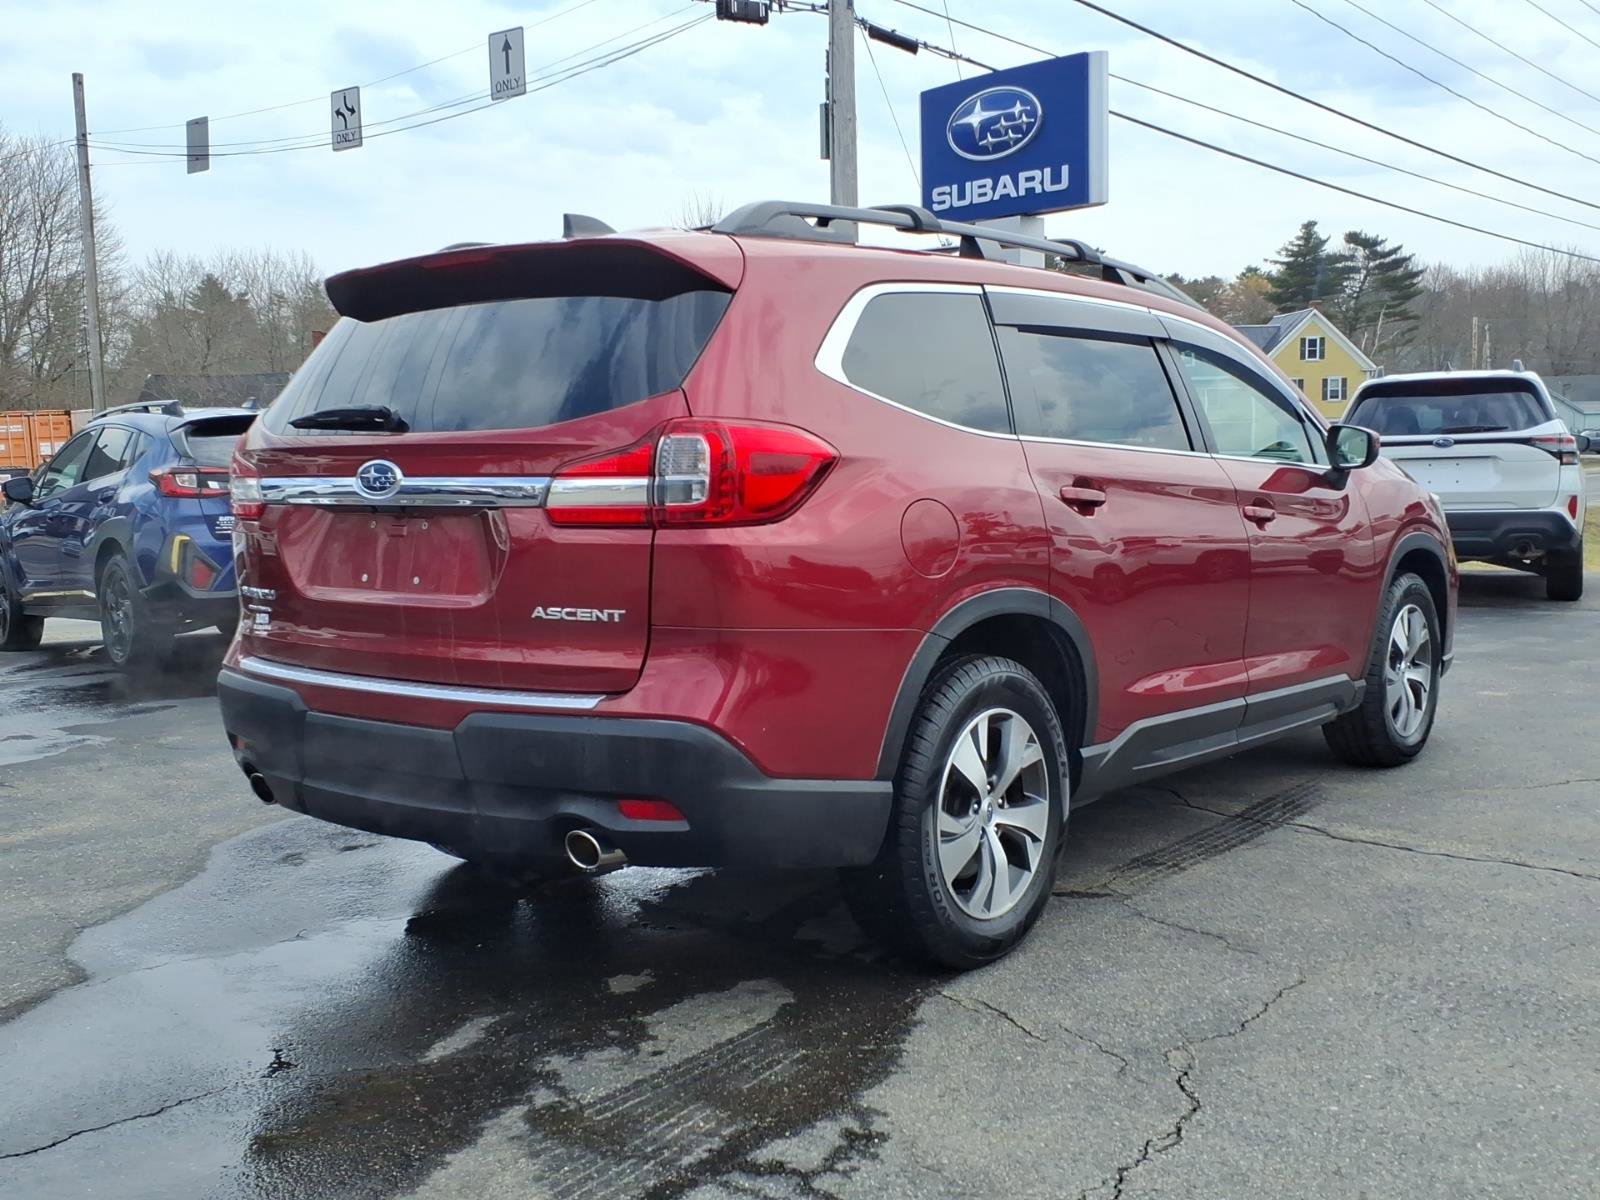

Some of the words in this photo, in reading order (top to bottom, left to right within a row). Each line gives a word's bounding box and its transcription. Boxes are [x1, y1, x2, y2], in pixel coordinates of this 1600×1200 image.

[495, 77, 520, 93] ONLY
[337, 130, 356, 144] ONLY
[932, 164, 1069, 212] SUBARU
[531, 606, 626, 622] ASCENT
